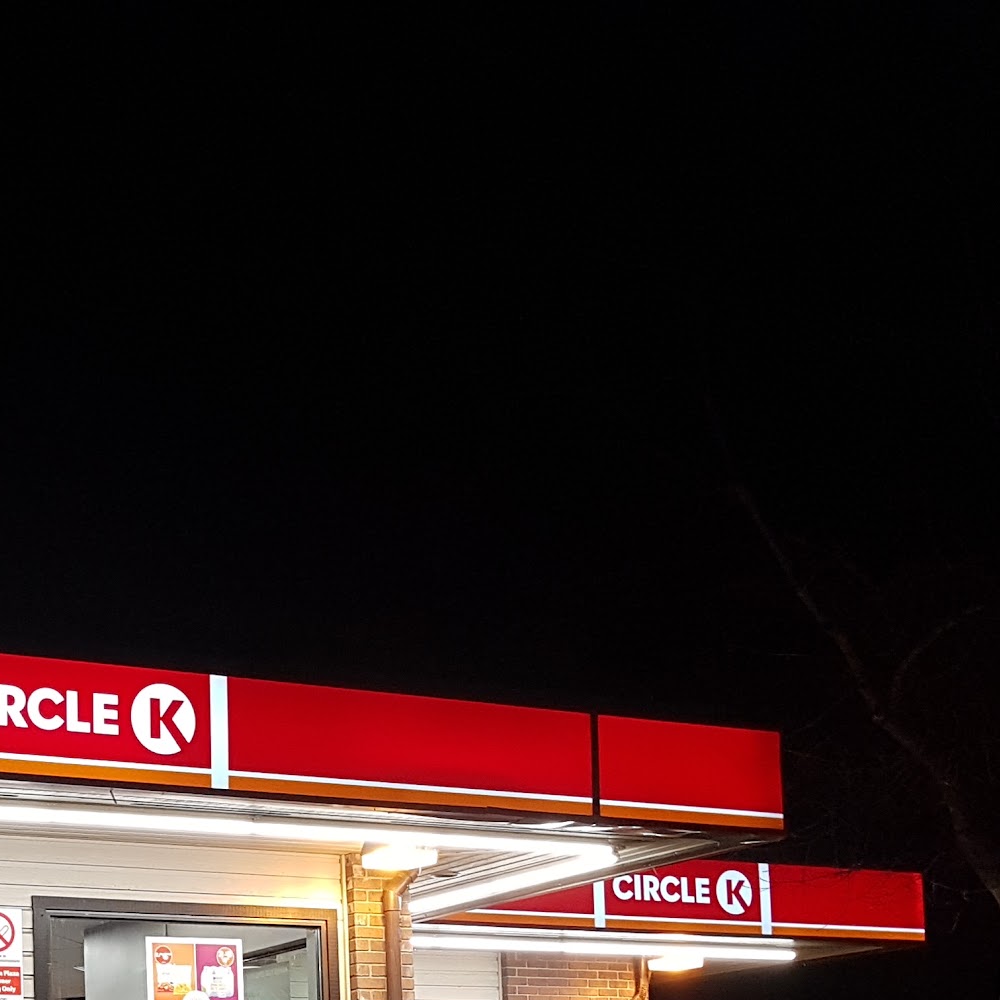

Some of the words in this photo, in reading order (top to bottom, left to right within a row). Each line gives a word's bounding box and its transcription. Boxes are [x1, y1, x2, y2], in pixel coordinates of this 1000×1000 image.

[143, 692, 194, 753] K
[612, 874, 711, 904] CIRCLE
[721, 875, 752, 912] K
